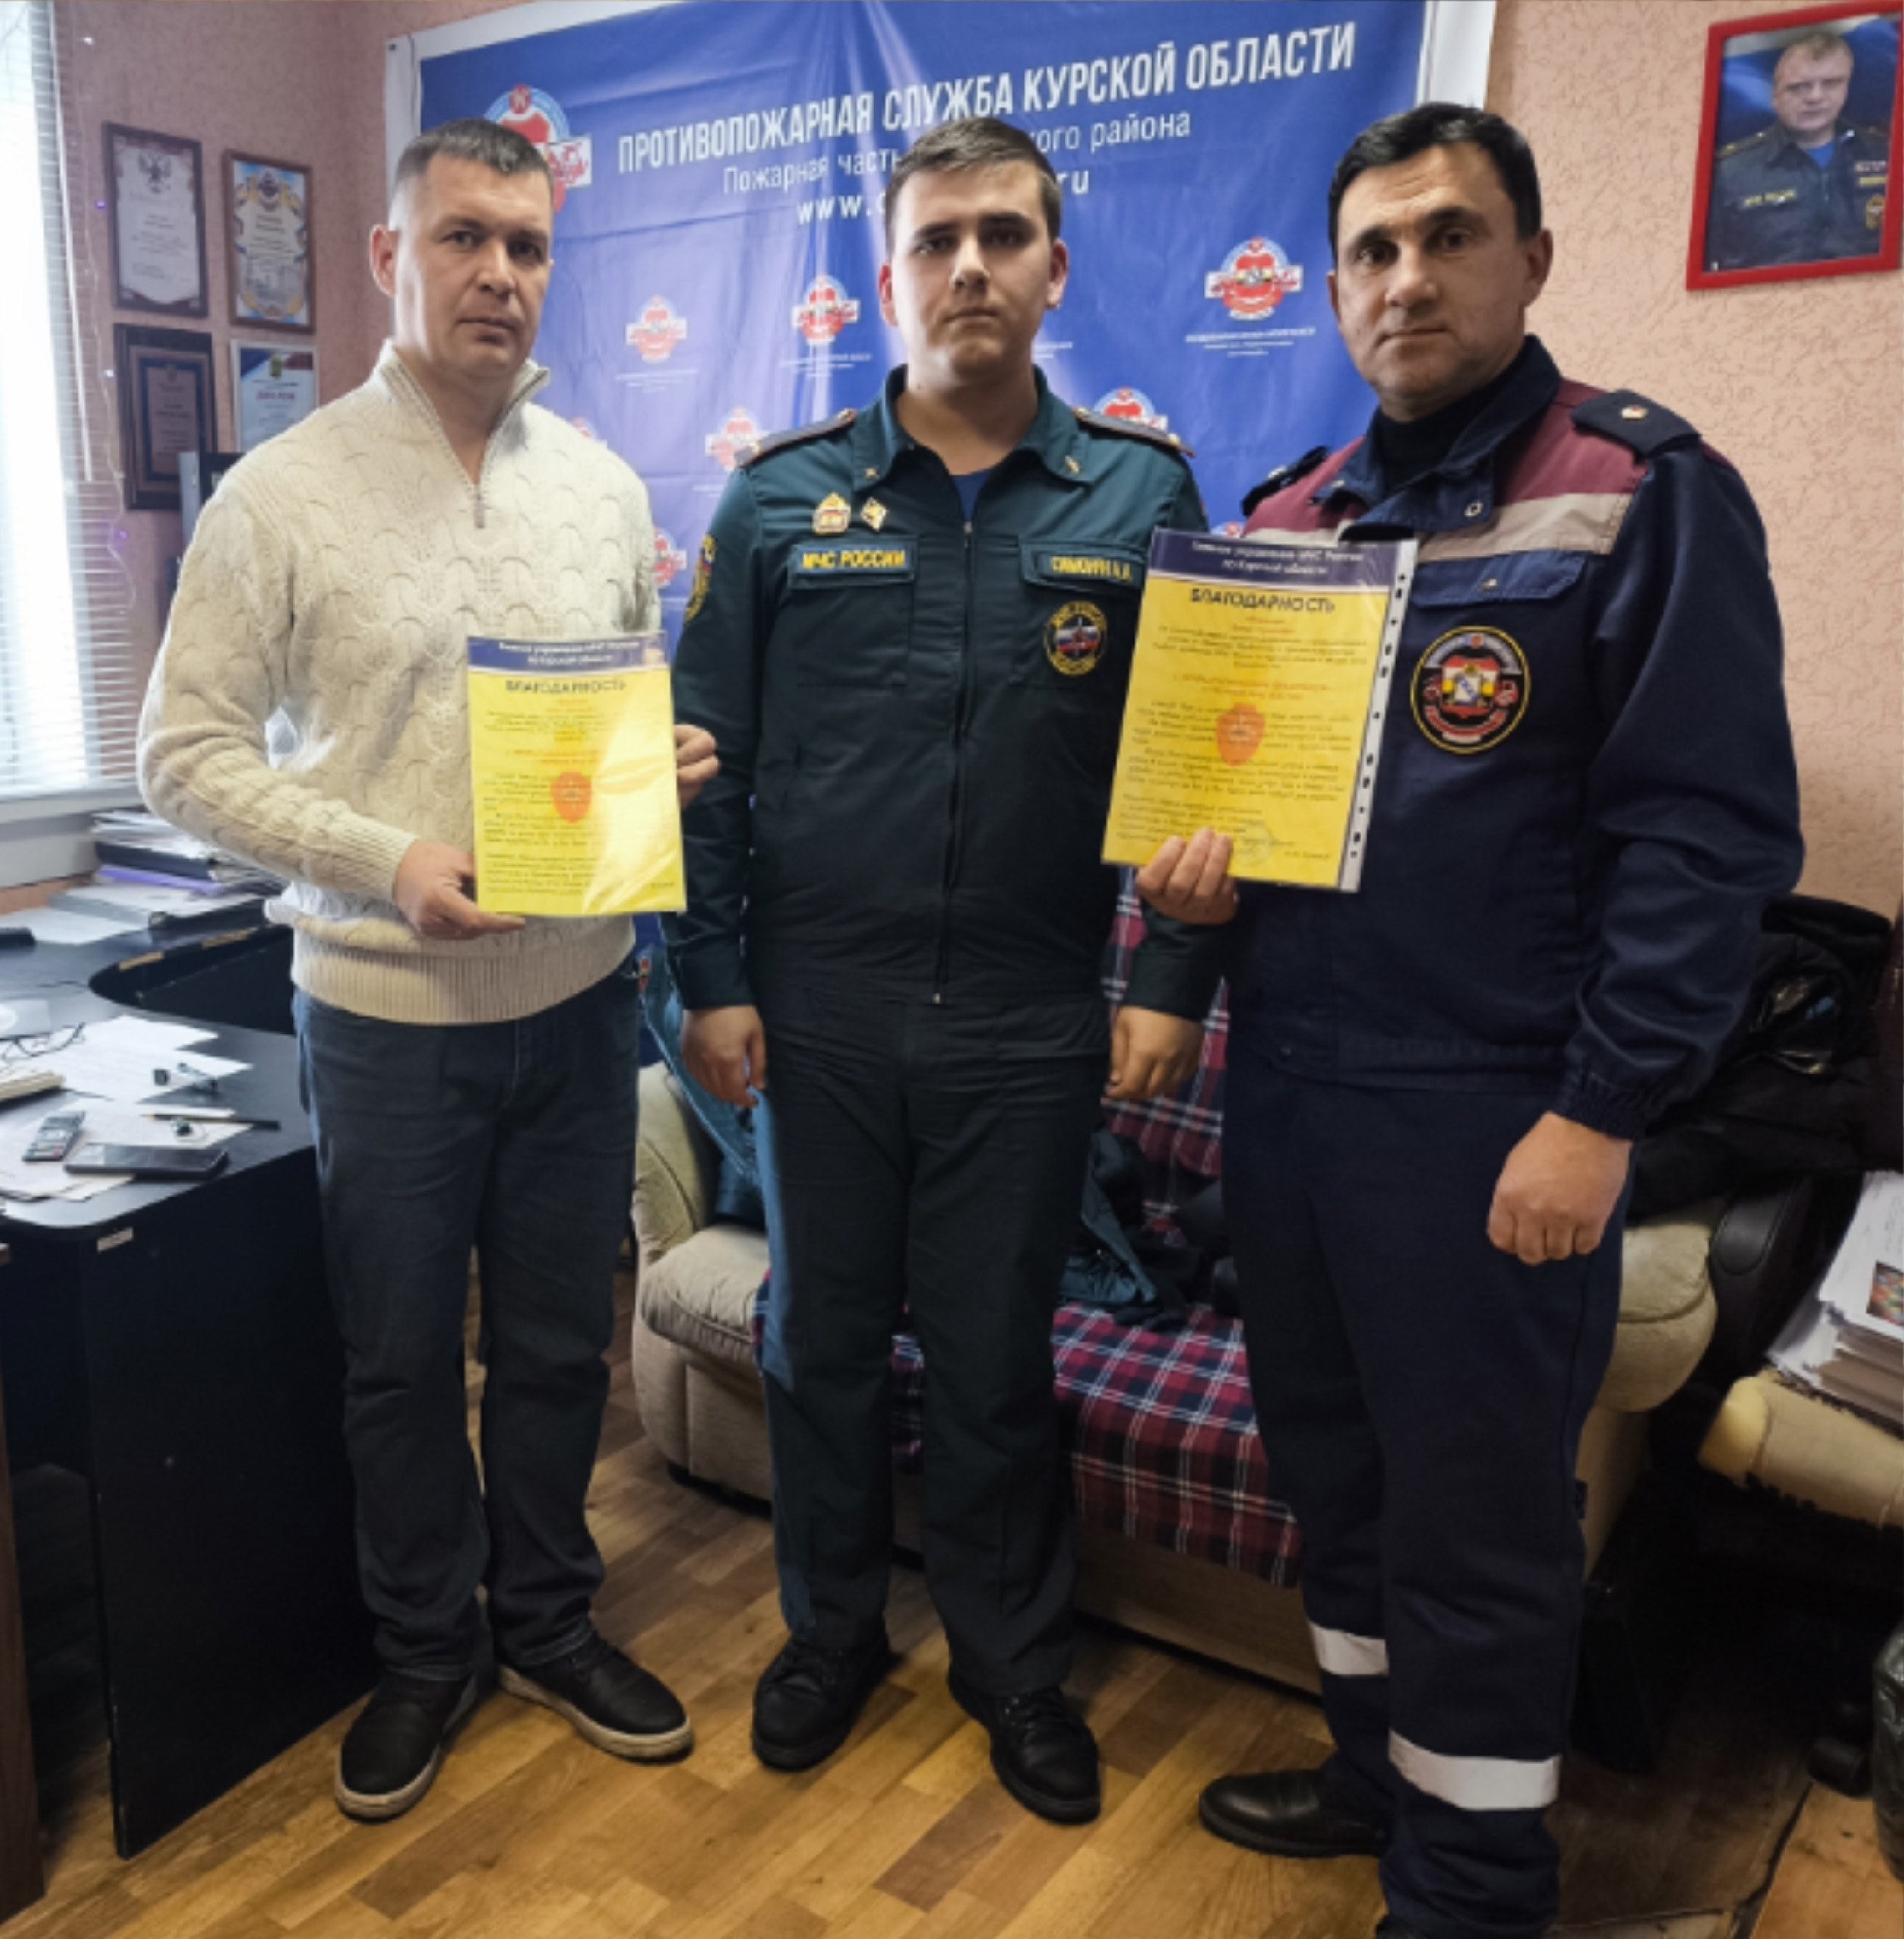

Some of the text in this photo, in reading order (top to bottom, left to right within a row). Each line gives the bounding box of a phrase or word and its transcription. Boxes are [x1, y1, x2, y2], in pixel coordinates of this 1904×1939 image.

[618, 92, 872, 174] ПРОТИВОПОЖАРНАЯ
[883, 74, 1013, 132] СЛУЖБА
[1024, 42, 1175, 113] КУРСКОЙ
[1186, 21, 1356, 90] ОБЛАСТИ
[723, 157, 829, 195] Пожарная
[1090, 111, 1191, 154] района
[840, 548, 906, 570] РОССИИ
[1191, 587, 1336, 614] БЛАГОДАРНОСТЬ
